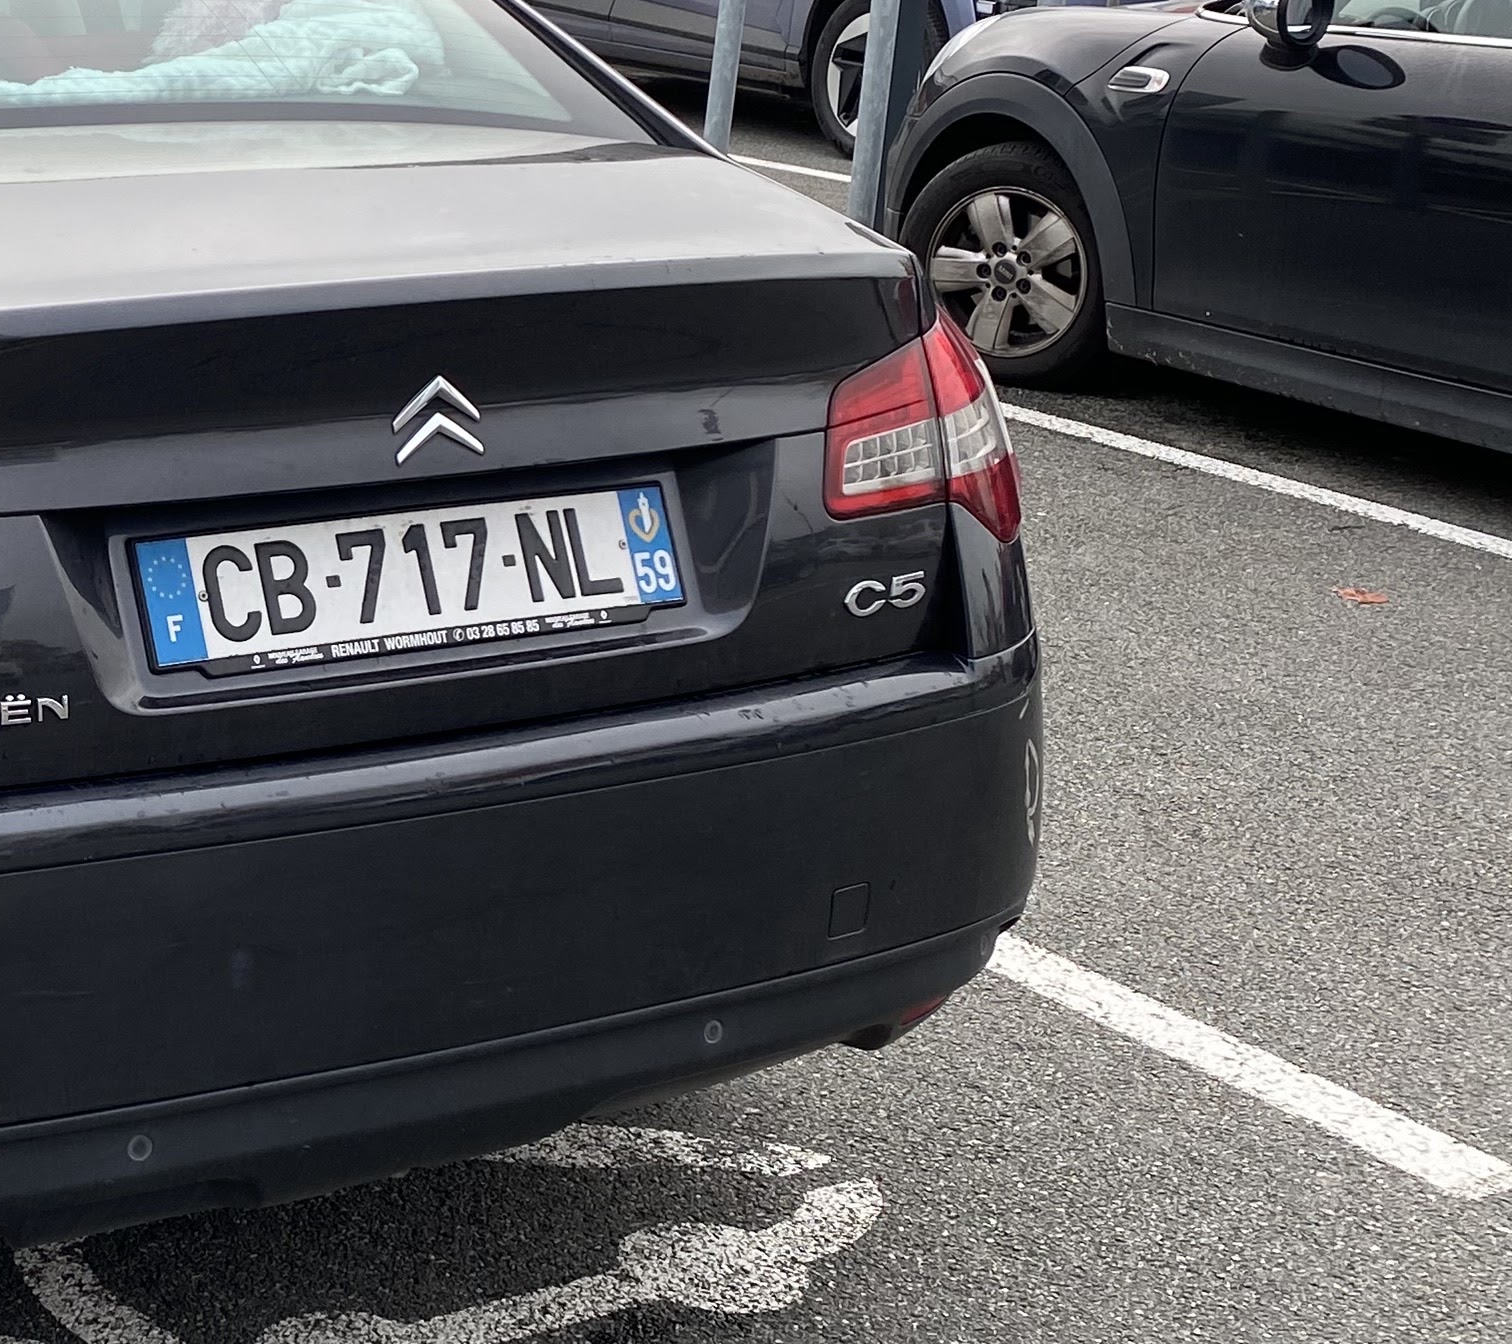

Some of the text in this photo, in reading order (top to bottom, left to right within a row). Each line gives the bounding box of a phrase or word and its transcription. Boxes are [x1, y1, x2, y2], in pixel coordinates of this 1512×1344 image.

[202, 508, 625, 643] CB-717-NL
[633, 549, 677, 594] 59
[844, 570, 926, 617] C5
[166, 613, 184, 644] F
[330, 639, 380, 659] RENAULT
[384, 629, 448, 652] WORMHOUT
[466, 627, 481, 641] 03
[482, 624, 495, 639] 28
[496, 622, 510, 637] 65
[511, 620, 525, 635] 85
[525, 618, 540, 633] 85
